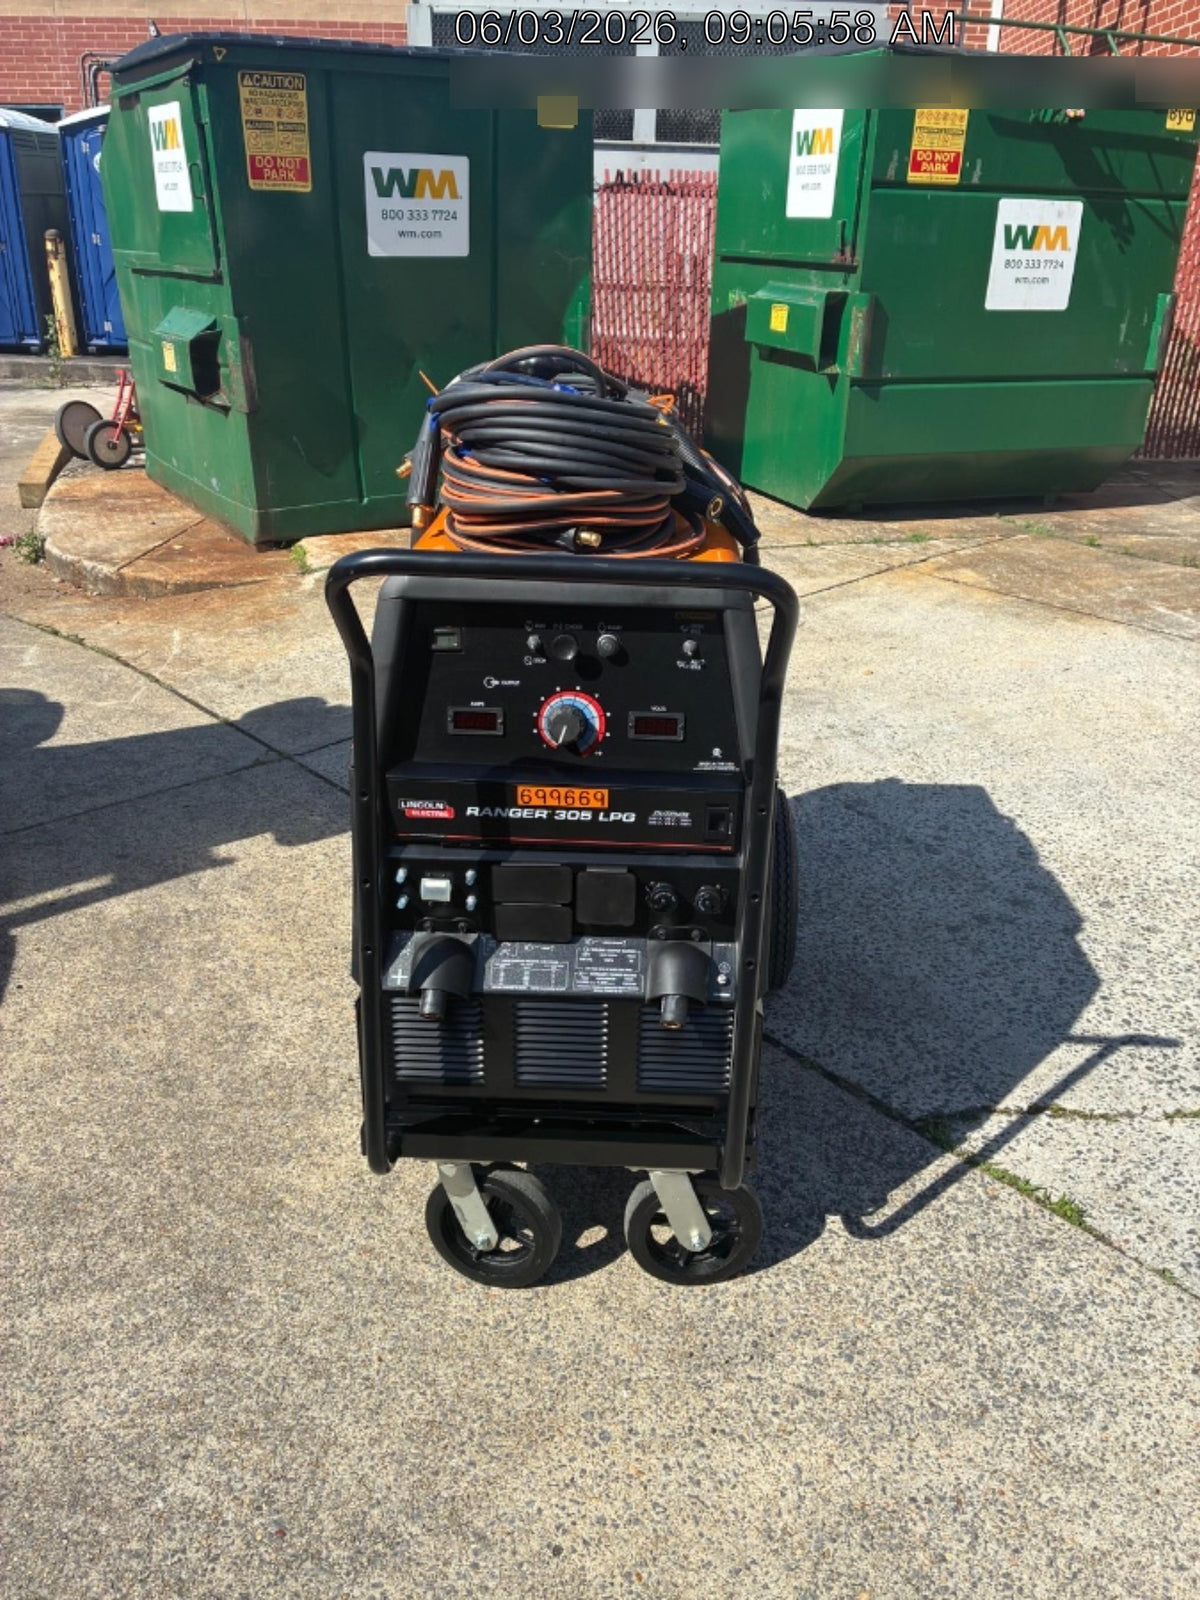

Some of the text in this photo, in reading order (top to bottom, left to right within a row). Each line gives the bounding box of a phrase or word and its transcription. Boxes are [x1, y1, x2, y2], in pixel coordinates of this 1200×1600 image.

[252, 75, 304, 90] CAUTION
[152, 116, 181, 151] WM
[796, 127, 834, 157] WM
[255, 156, 300, 170] DO NOT
[917, 150, 956, 163] DO NOT
[921, 161, 949, 173] PARK
[263, 168, 296, 181] PARK
[371, 166, 463, 201] WM
[381, 208, 458, 221] 800 333 7724
[398, 229, 443, 240] wm.com
[1004, 223, 1070, 251] WM
[1004, 259, 1065, 270] 800 333 7724
[520, 788, 606, 807] 699669
[401, 800, 447, 810] LINCOLN
[466, 806, 549, 820] RANGER
[554, 809, 593, 821] 305
[598, 811, 637, 823] LPG
